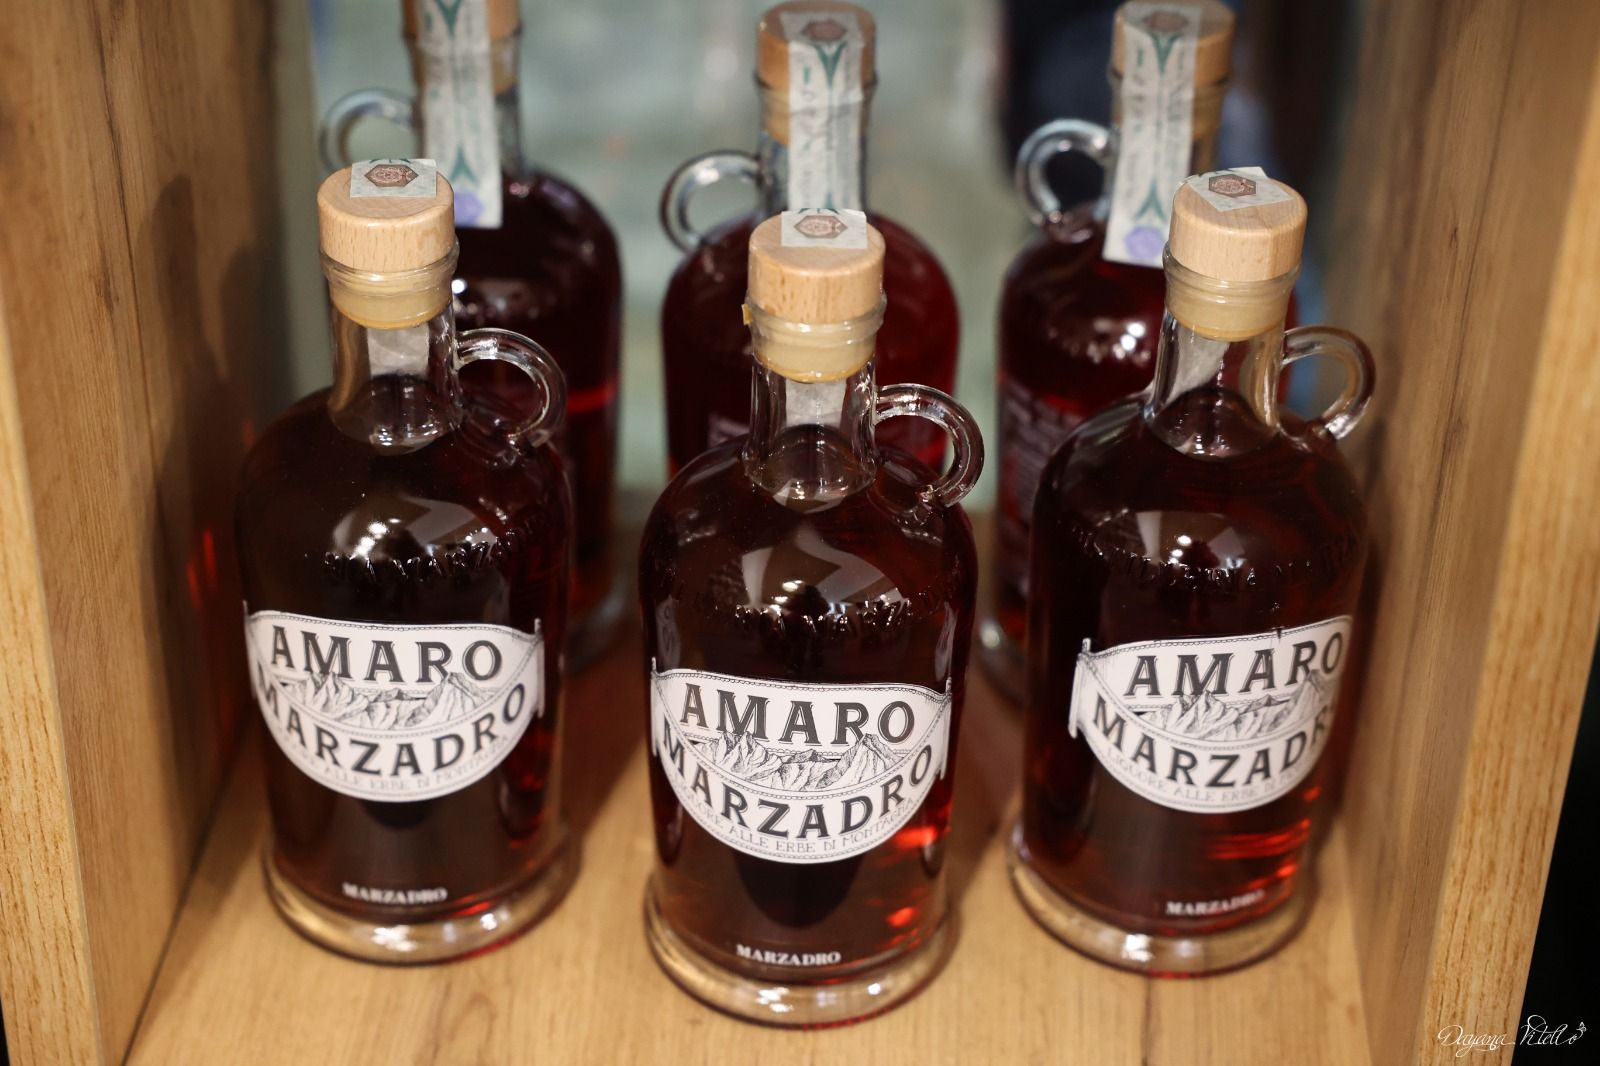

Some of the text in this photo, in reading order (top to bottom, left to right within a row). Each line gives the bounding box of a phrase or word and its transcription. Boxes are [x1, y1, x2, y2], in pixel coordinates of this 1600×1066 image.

[271, 626, 503, 683] AMARO
[1124, 632, 1344, 697] AMARO
[258, 660, 526, 777] MARZADRO
[680, 683, 916, 746] AMARO
[663, 715, 933, 839] MARZADRO
[776, 841, 816, 853] ERBE
[824, 840, 837, 851] DI
[342, 882, 449, 904] MARZADRO
[736, 944, 842, 966] MARZADRO
